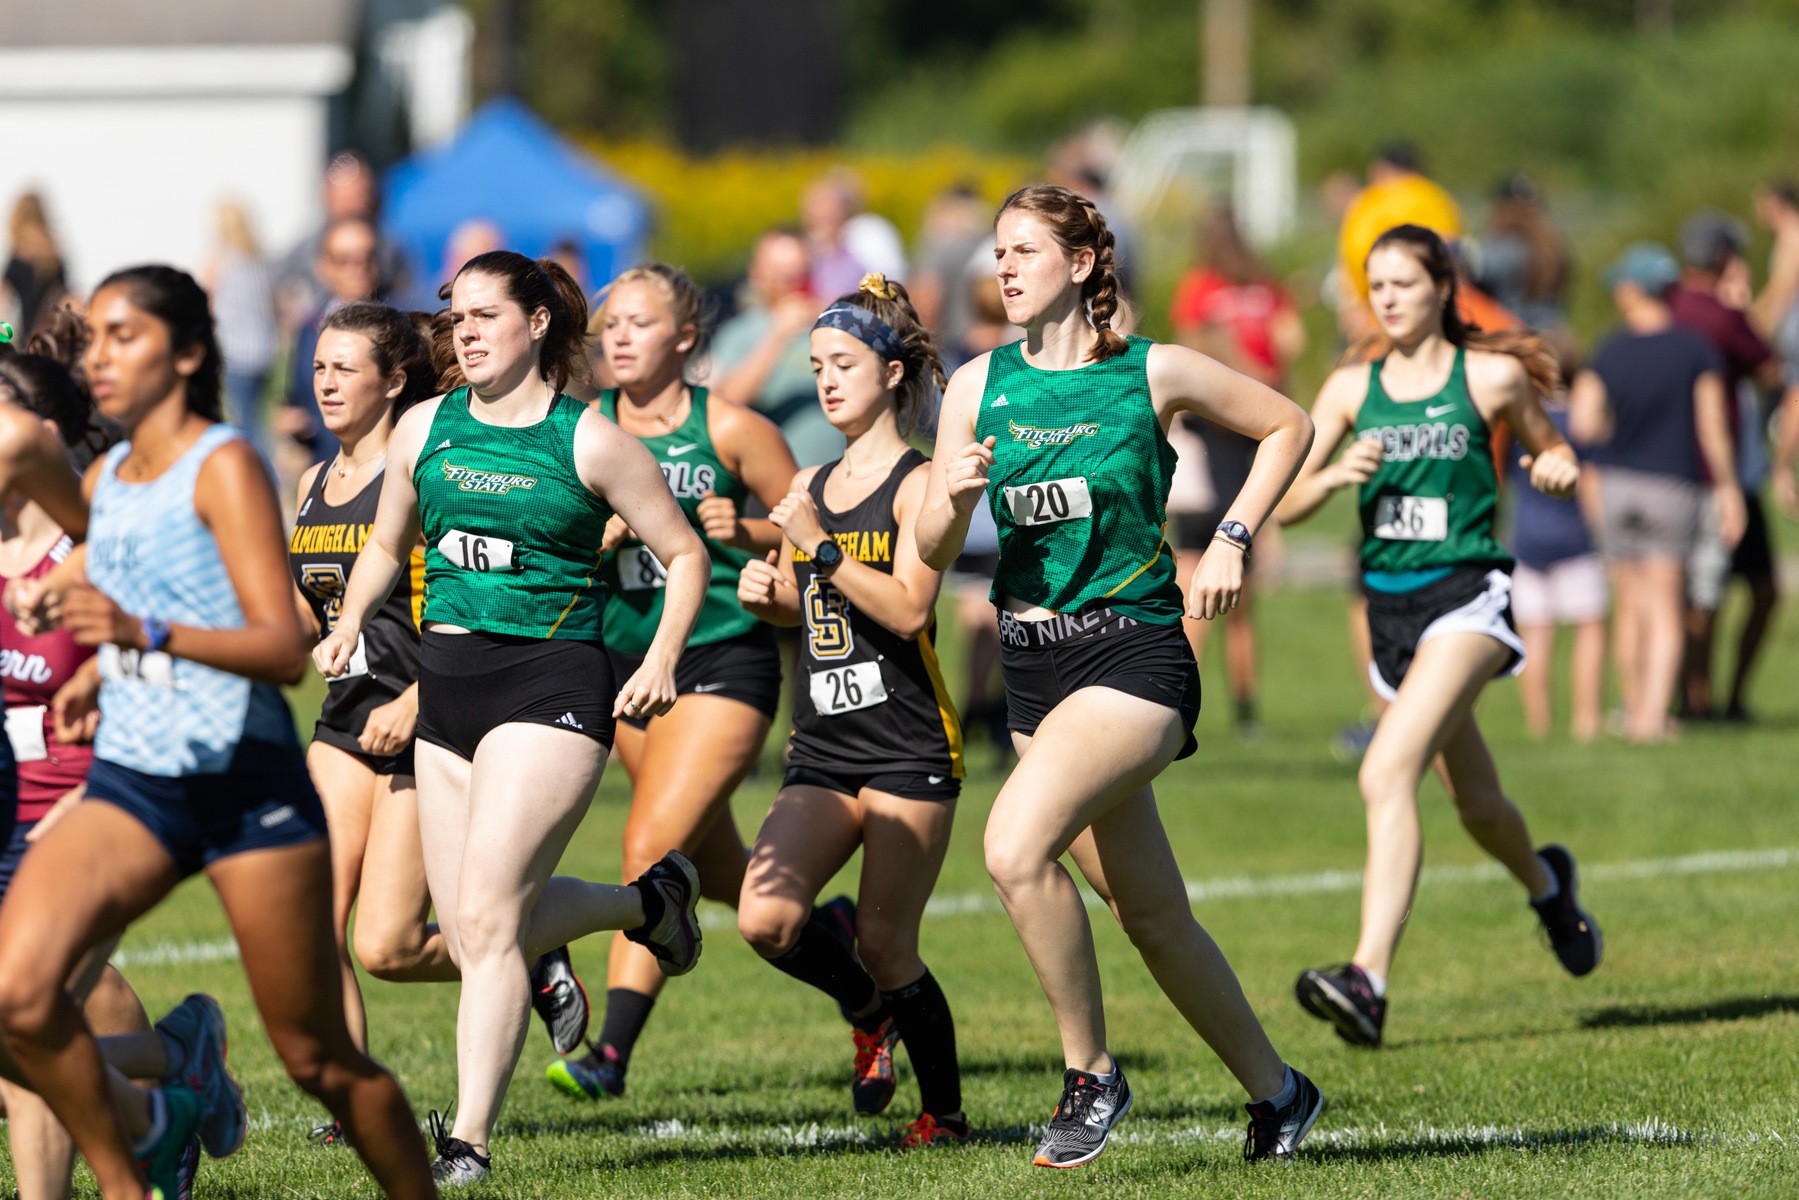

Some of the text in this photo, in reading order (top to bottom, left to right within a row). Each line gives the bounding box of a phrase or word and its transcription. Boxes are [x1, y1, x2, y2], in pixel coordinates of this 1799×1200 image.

[1009, 420, 1098, 440] FITCHURG
[1028, 433, 1074, 448] SATE
[444, 462, 537, 488] FITCHBURG
[459, 480, 510, 493] STATE
[1026, 482, 1069, 522] 20
[459, 535, 490, 572] 16
[1001, 620, 1030, 647] PRO
[1037, 604, 1100, 645] NIKE
[826, 668, 863, 710] 26
